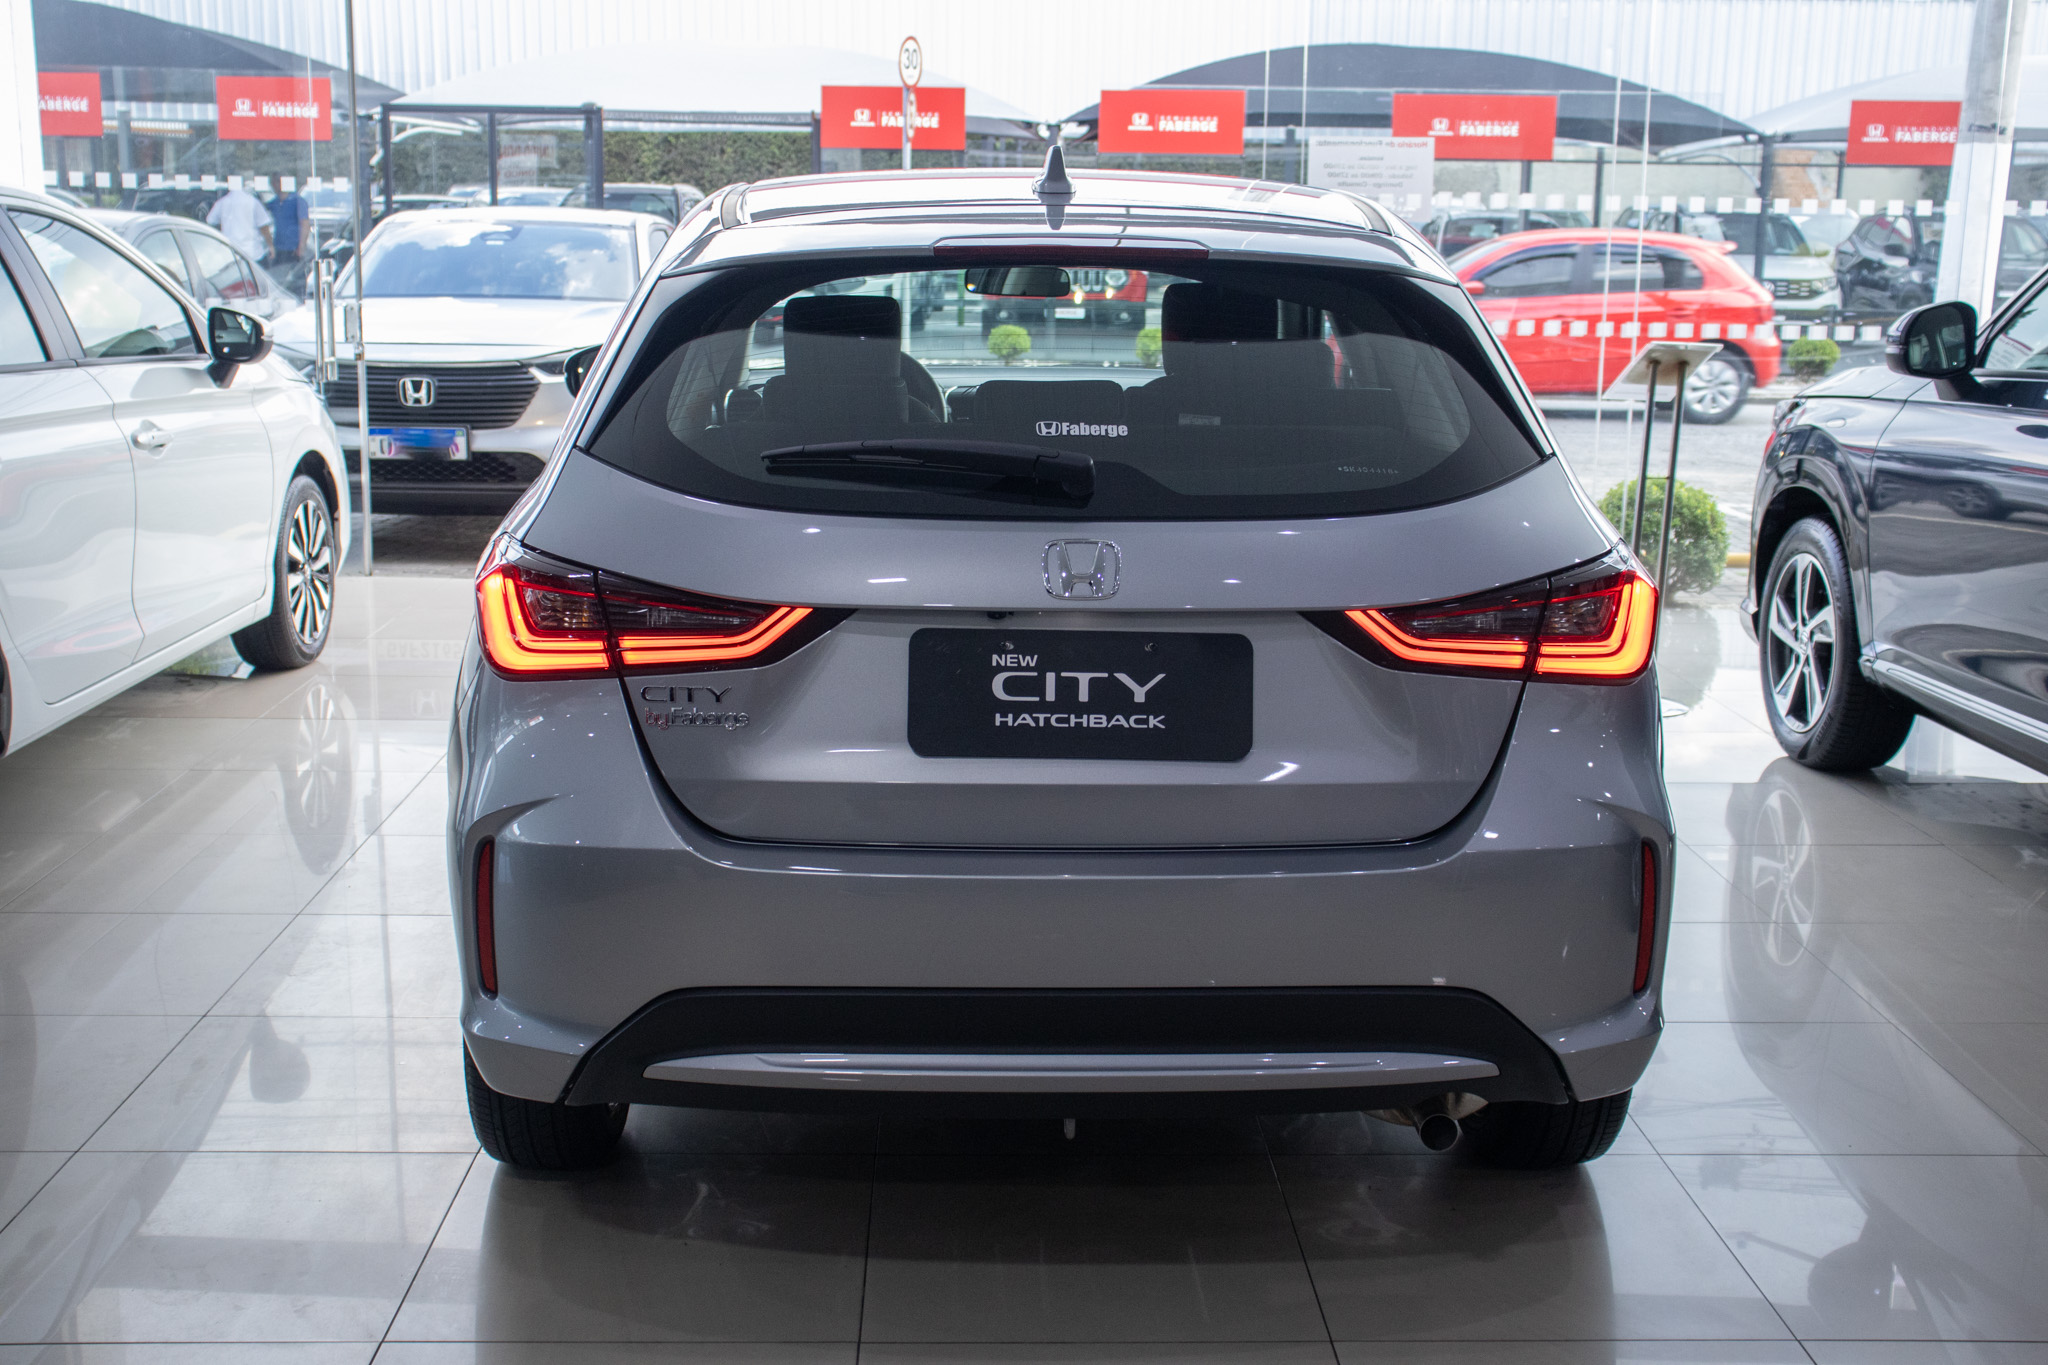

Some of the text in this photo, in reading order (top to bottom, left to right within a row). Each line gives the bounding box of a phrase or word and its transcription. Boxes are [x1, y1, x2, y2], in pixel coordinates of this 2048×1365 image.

[904, 48, 918, 70] 30
[39, 99, 89, 112] ABERGE
[262, 106, 319, 118] FABERGE
[881, 115, 939, 128] FABRGE
[1159, 120, 1218, 132] FABERGE
[1460, 125, 1519, 137] FABERGE
[1895, 131, 1957, 143] FABERGE
[1062, 422, 1128, 437] Faberge
[992, 654, 1038, 667] NEW
[992, 671, 1166, 703] CITY
[641, 686, 732, 702] CITY
[995, 713, 1165, 728] HATCHBACK
